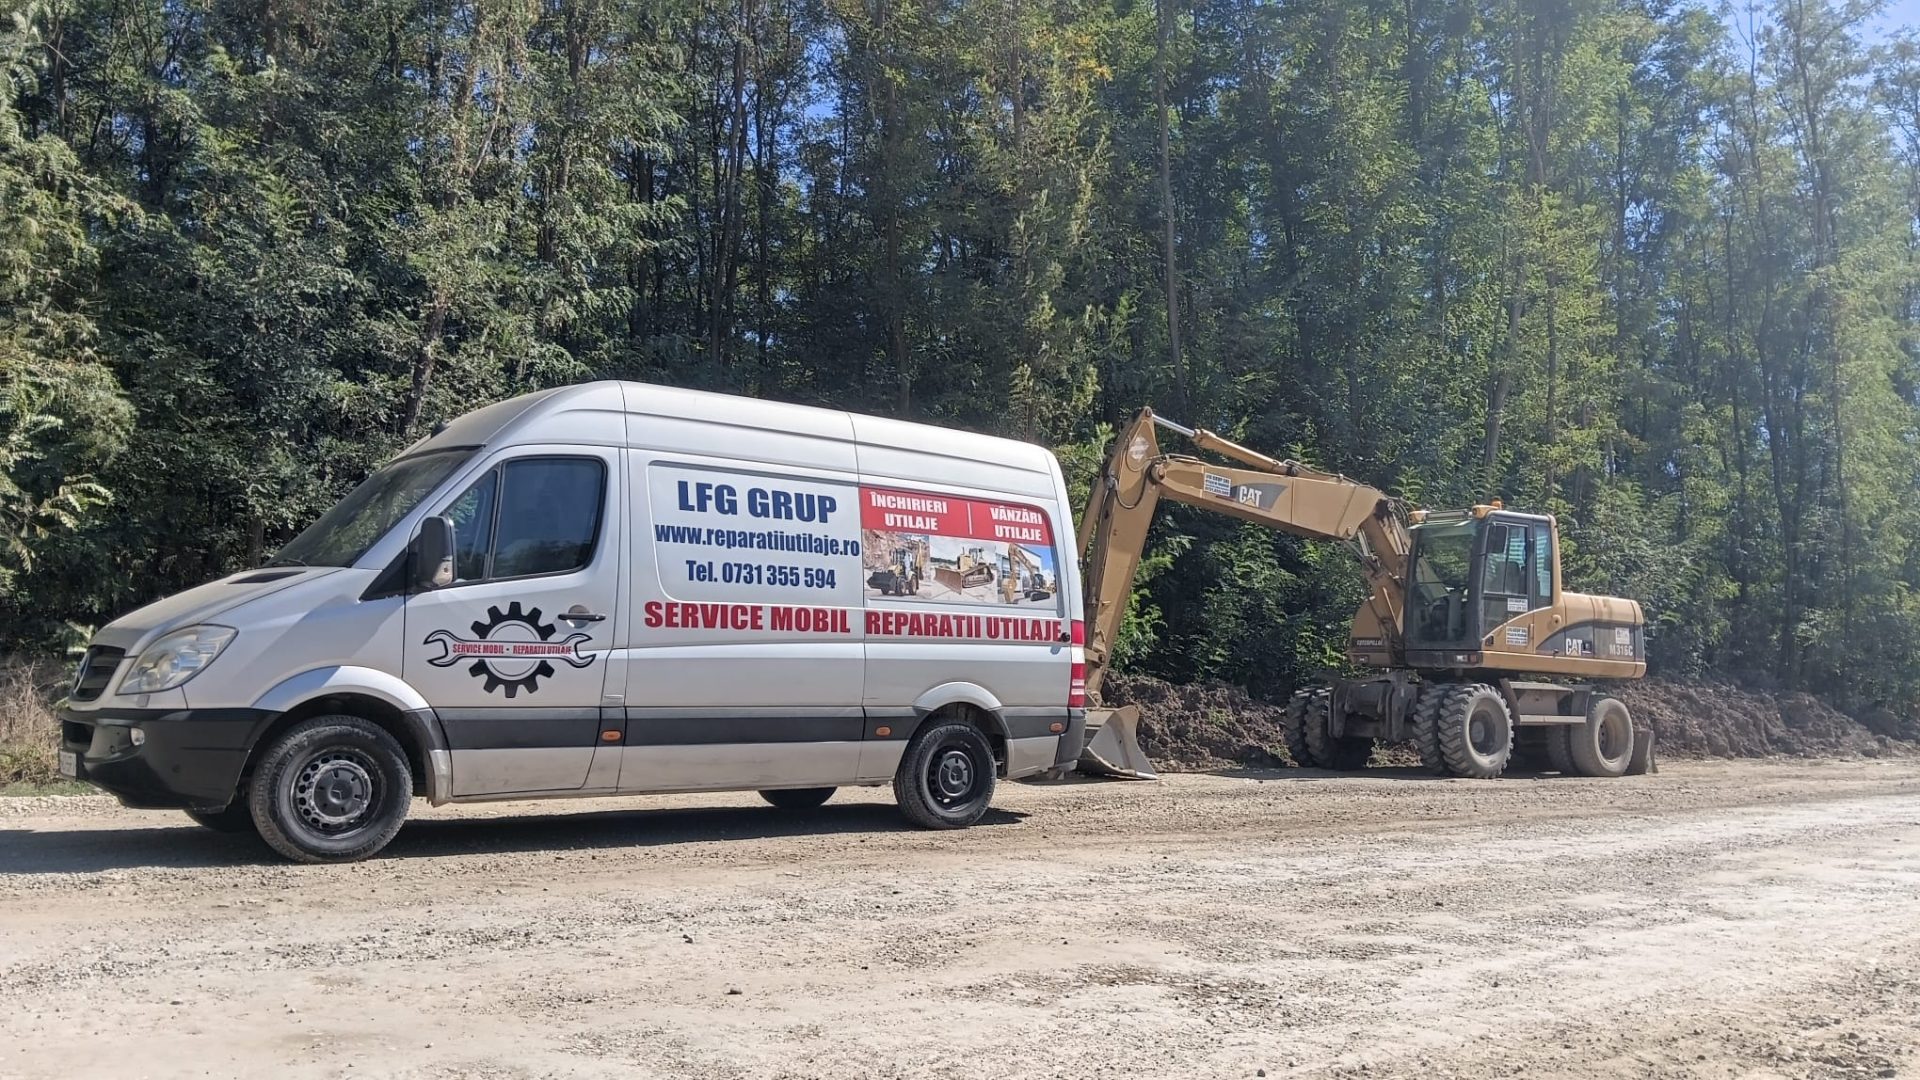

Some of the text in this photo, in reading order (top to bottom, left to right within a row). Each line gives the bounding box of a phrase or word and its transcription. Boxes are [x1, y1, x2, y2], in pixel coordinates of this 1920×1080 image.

[677, 480, 837, 523] LFG GRUP
[870, 491, 948, 514] ÎNCHIRIERI
[1239, 485, 1262, 508] CAT
[884, 513, 938, 531] UTILAJE
[990, 506, 1043, 525] VÂNZĂRI
[655, 524, 860, 557] www.reparatiiutilaje.ro
[994, 526, 1042, 542] UTILAJE
[686, 560, 836, 589] Tel. 0731 355 594
[644, 601, 1062, 642] SERVICE MOBIL REPARATII UTILAJE
[452, 644, 482, 653] SERVICE
[1565, 637, 1583, 656] CAT
